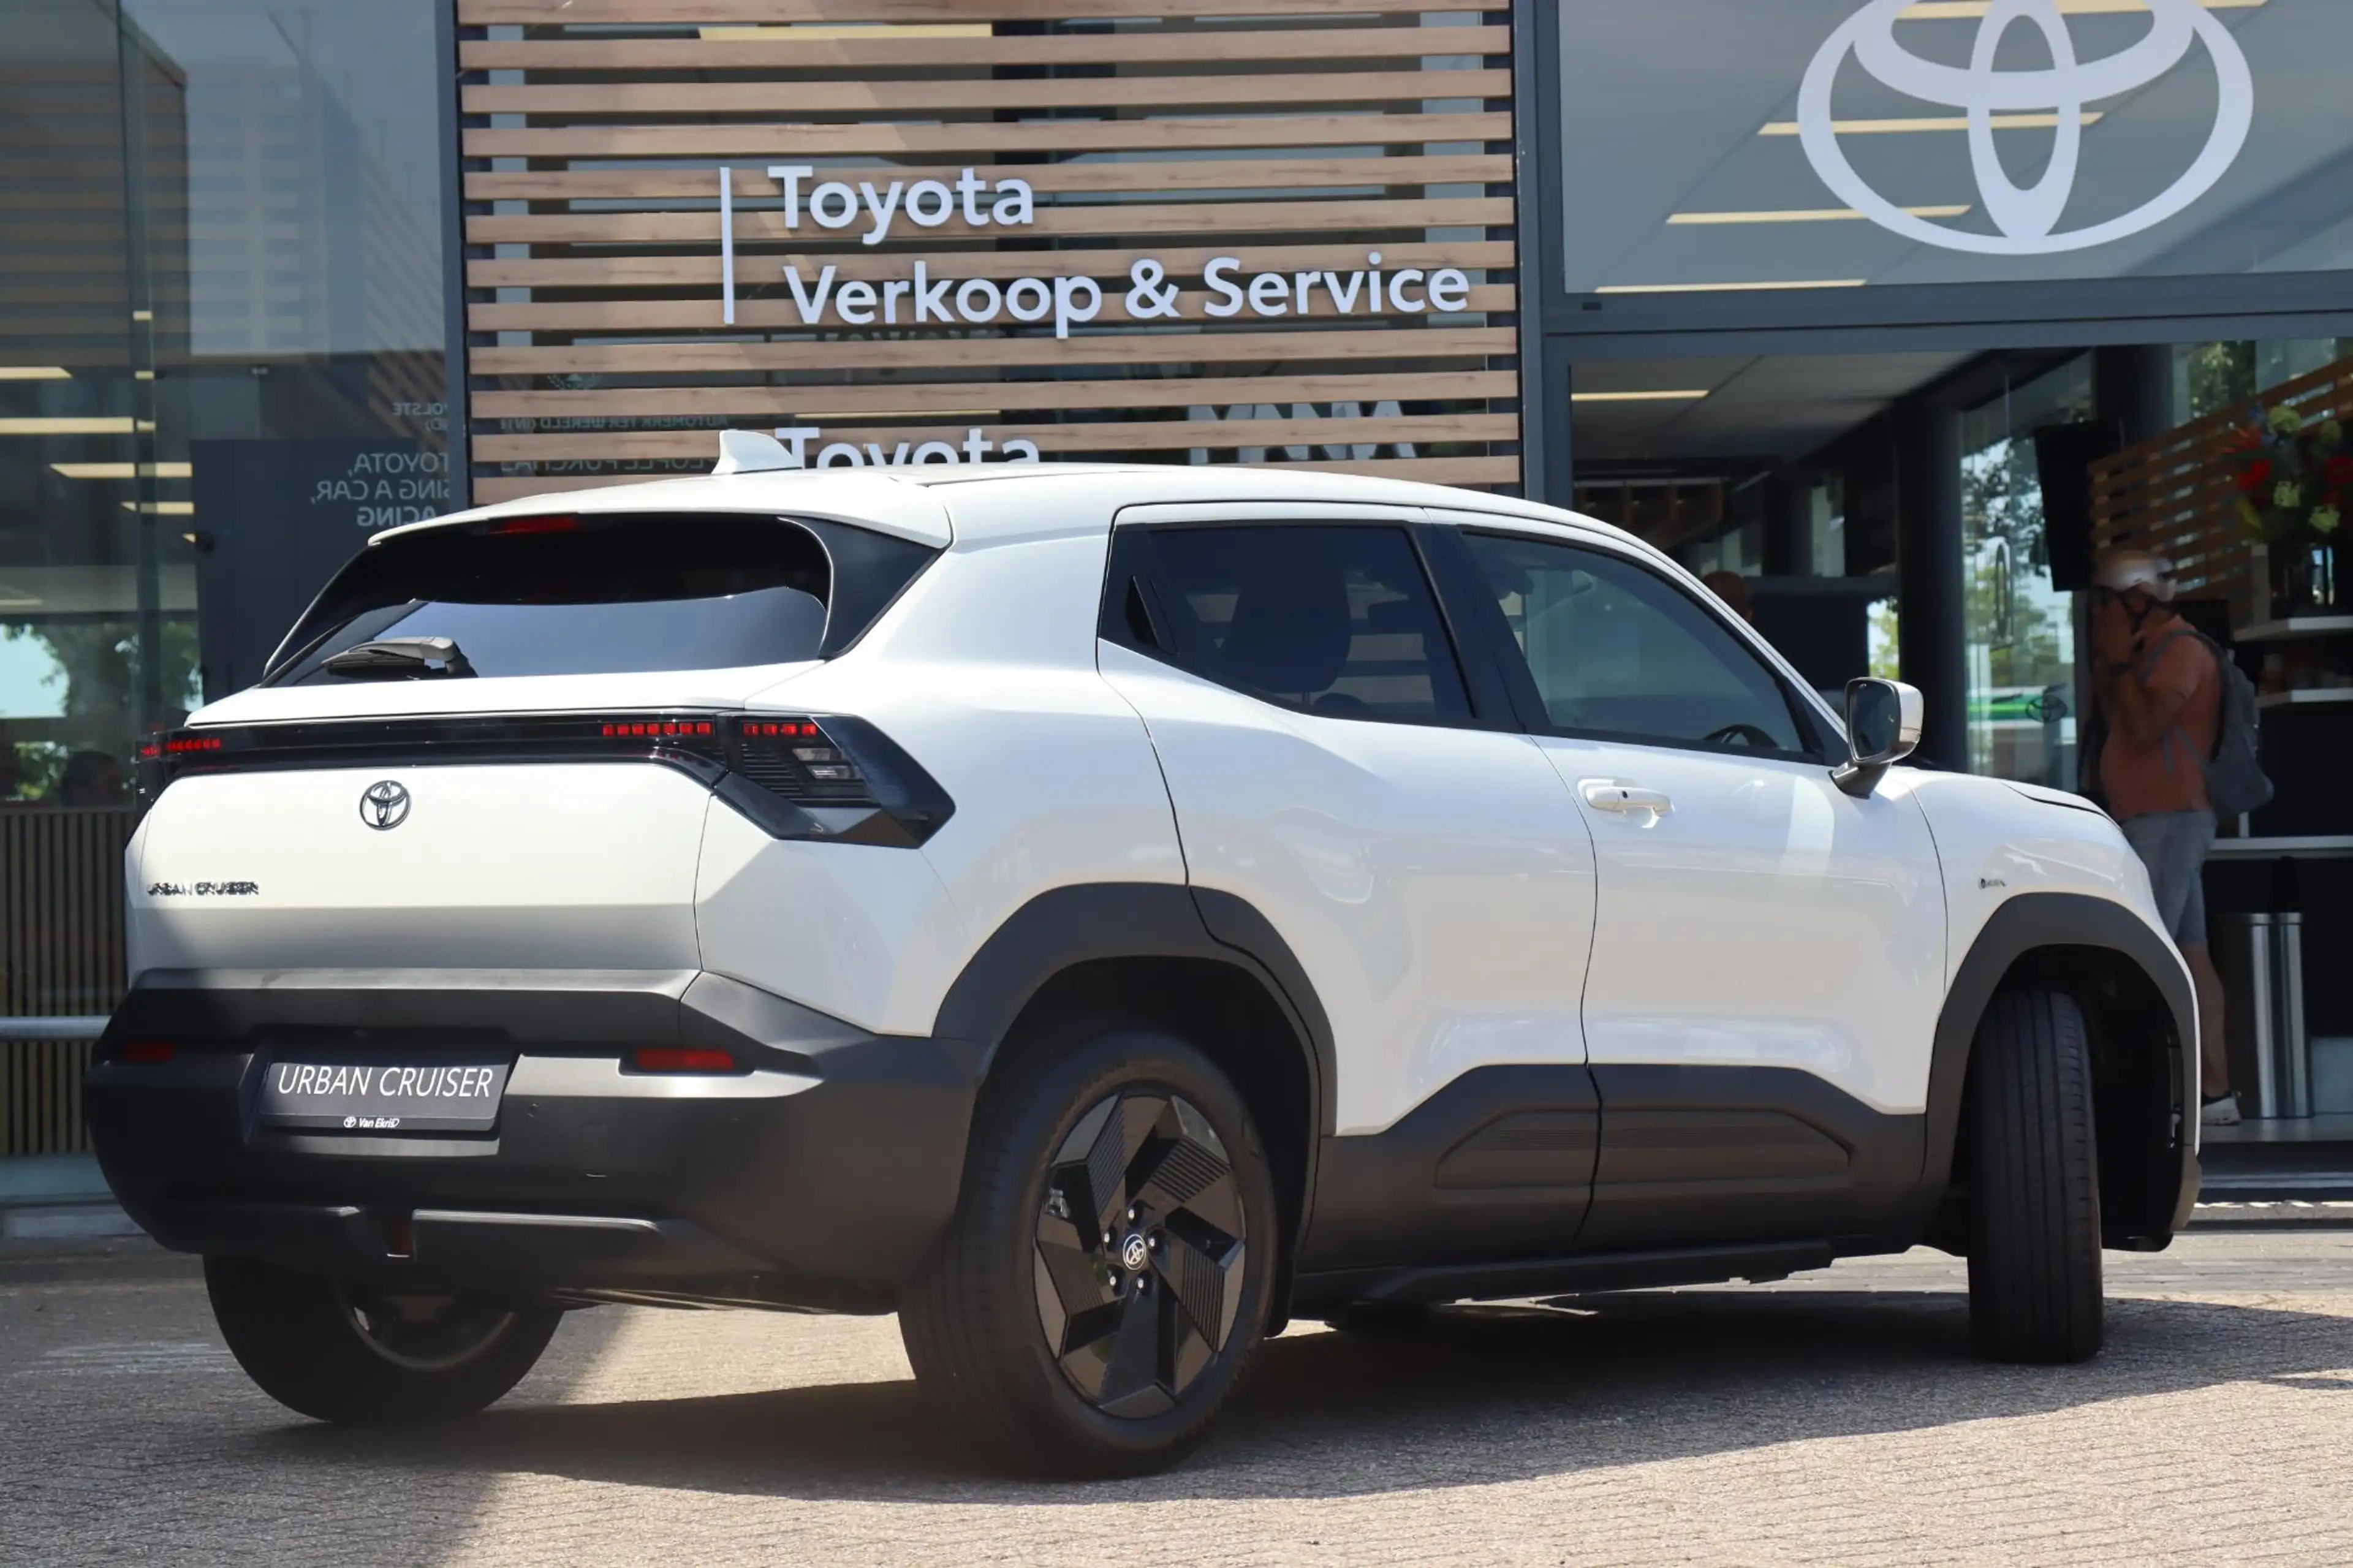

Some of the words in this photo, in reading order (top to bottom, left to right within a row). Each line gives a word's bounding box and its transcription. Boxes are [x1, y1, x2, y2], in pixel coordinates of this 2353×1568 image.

[767, 165, 1033, 245] Toyota
[782, 260, 1102, 339] Verkoop
[1125, 259, 1181, 318] &
[1203, 252, 1469, 317] Service
[278, 1065, 373, 1095] URBAN
[379, 1066, 493, 1097] CRUISER
[359, 1117, 374, 1128] Van
